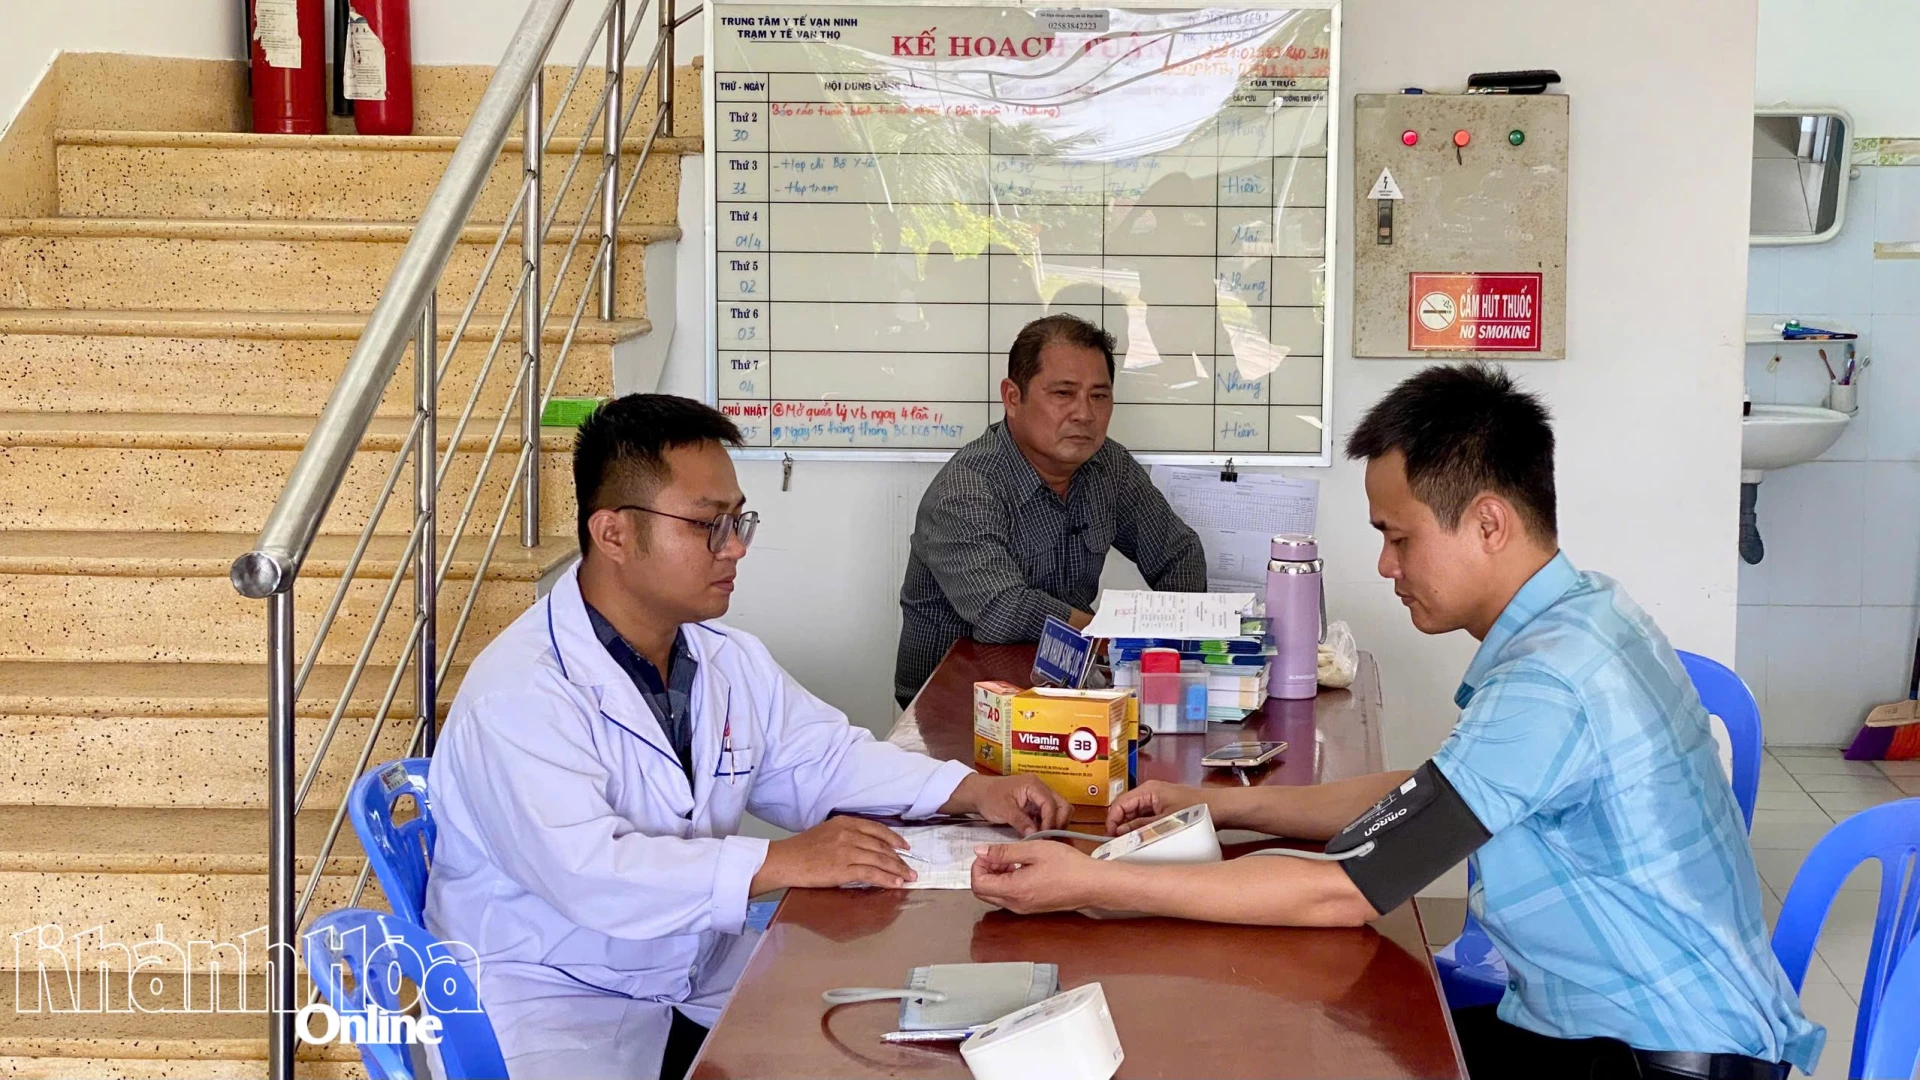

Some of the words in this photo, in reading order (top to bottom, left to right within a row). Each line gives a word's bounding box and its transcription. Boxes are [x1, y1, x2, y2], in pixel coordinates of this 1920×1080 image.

[721, 17, 755, 26] TRUNG
[758, 15, 780, 26] TÂM
[784, 18, 790, 26] Y
[793, 14, 807, 26] TẾ
[810, 18, 830, 28] VẠN
[834, 18, 858, 27] NINH
[1048, 22, 1097, 30] 02583842223
[737, 30, 767, 40] TRẠM
[770, 30, 777, 38] Y
[780, 28, 793, 38] TẾ
[796, 31, 817, 40] VẠN
[821, 31, 841, 40] THỌ
[891, 26, 937, 56] KẾ
[720, 82, 736, 91] THỨ
[744, 81, 765, 91] NGÀY
[844, 82, 871, 91] DUNG
[1271, 79, 1297, 88] TRỰC
[729, 112, 749, 122] Thứ
[752, 113, 757, 122] 2
[732, 129, 749, 142] 30
[729, 160, 749, 171] Thứ
[752, 161, 758, 171] 3
[732, 182, 746, 195] 31
[1222, 175, 1265, 194] Hiền
[729, 210, 749, 221] Thứ
[752, 212, 758, 221] 4
[735, 233, 761, 250] 01/4
[1231, 226, 1260, 244] Mai
[730, 260, 750, 271] Thứ
[752, 261, 758, 271] 5
[740, 279, 756, 293] 02
[1460, 285, 1479, 318] CẤM
[1482, 288, 1500, 318] HÚT
[1502, 285, 1532, 318] THUỐC
[730, 308, 750, 319] Thứ
[753, 308, 759, 318] 6
[738, 326, 756, 340] 03
[1460, 325, 1476, 338] NO
[1478, 325, 1531, 339] SMOKING
[730, 359, 750, 370] Thứ
[753, 360, 758, 370] 7
[739, 380, 754, 394] 04
[1216, 370, 1261, 399] Nhung
[722, 403, 741, 416] CHỦ
[744, 404, 768, 418] NHẬT
[901, 407, 908, 420] 4
[742, 427, 758, 439] 05
[811, 424, 824, 435] 15
[1018, 732, 1060, 745] Vitamin
[1074, 740, 1092, 751] 3B
